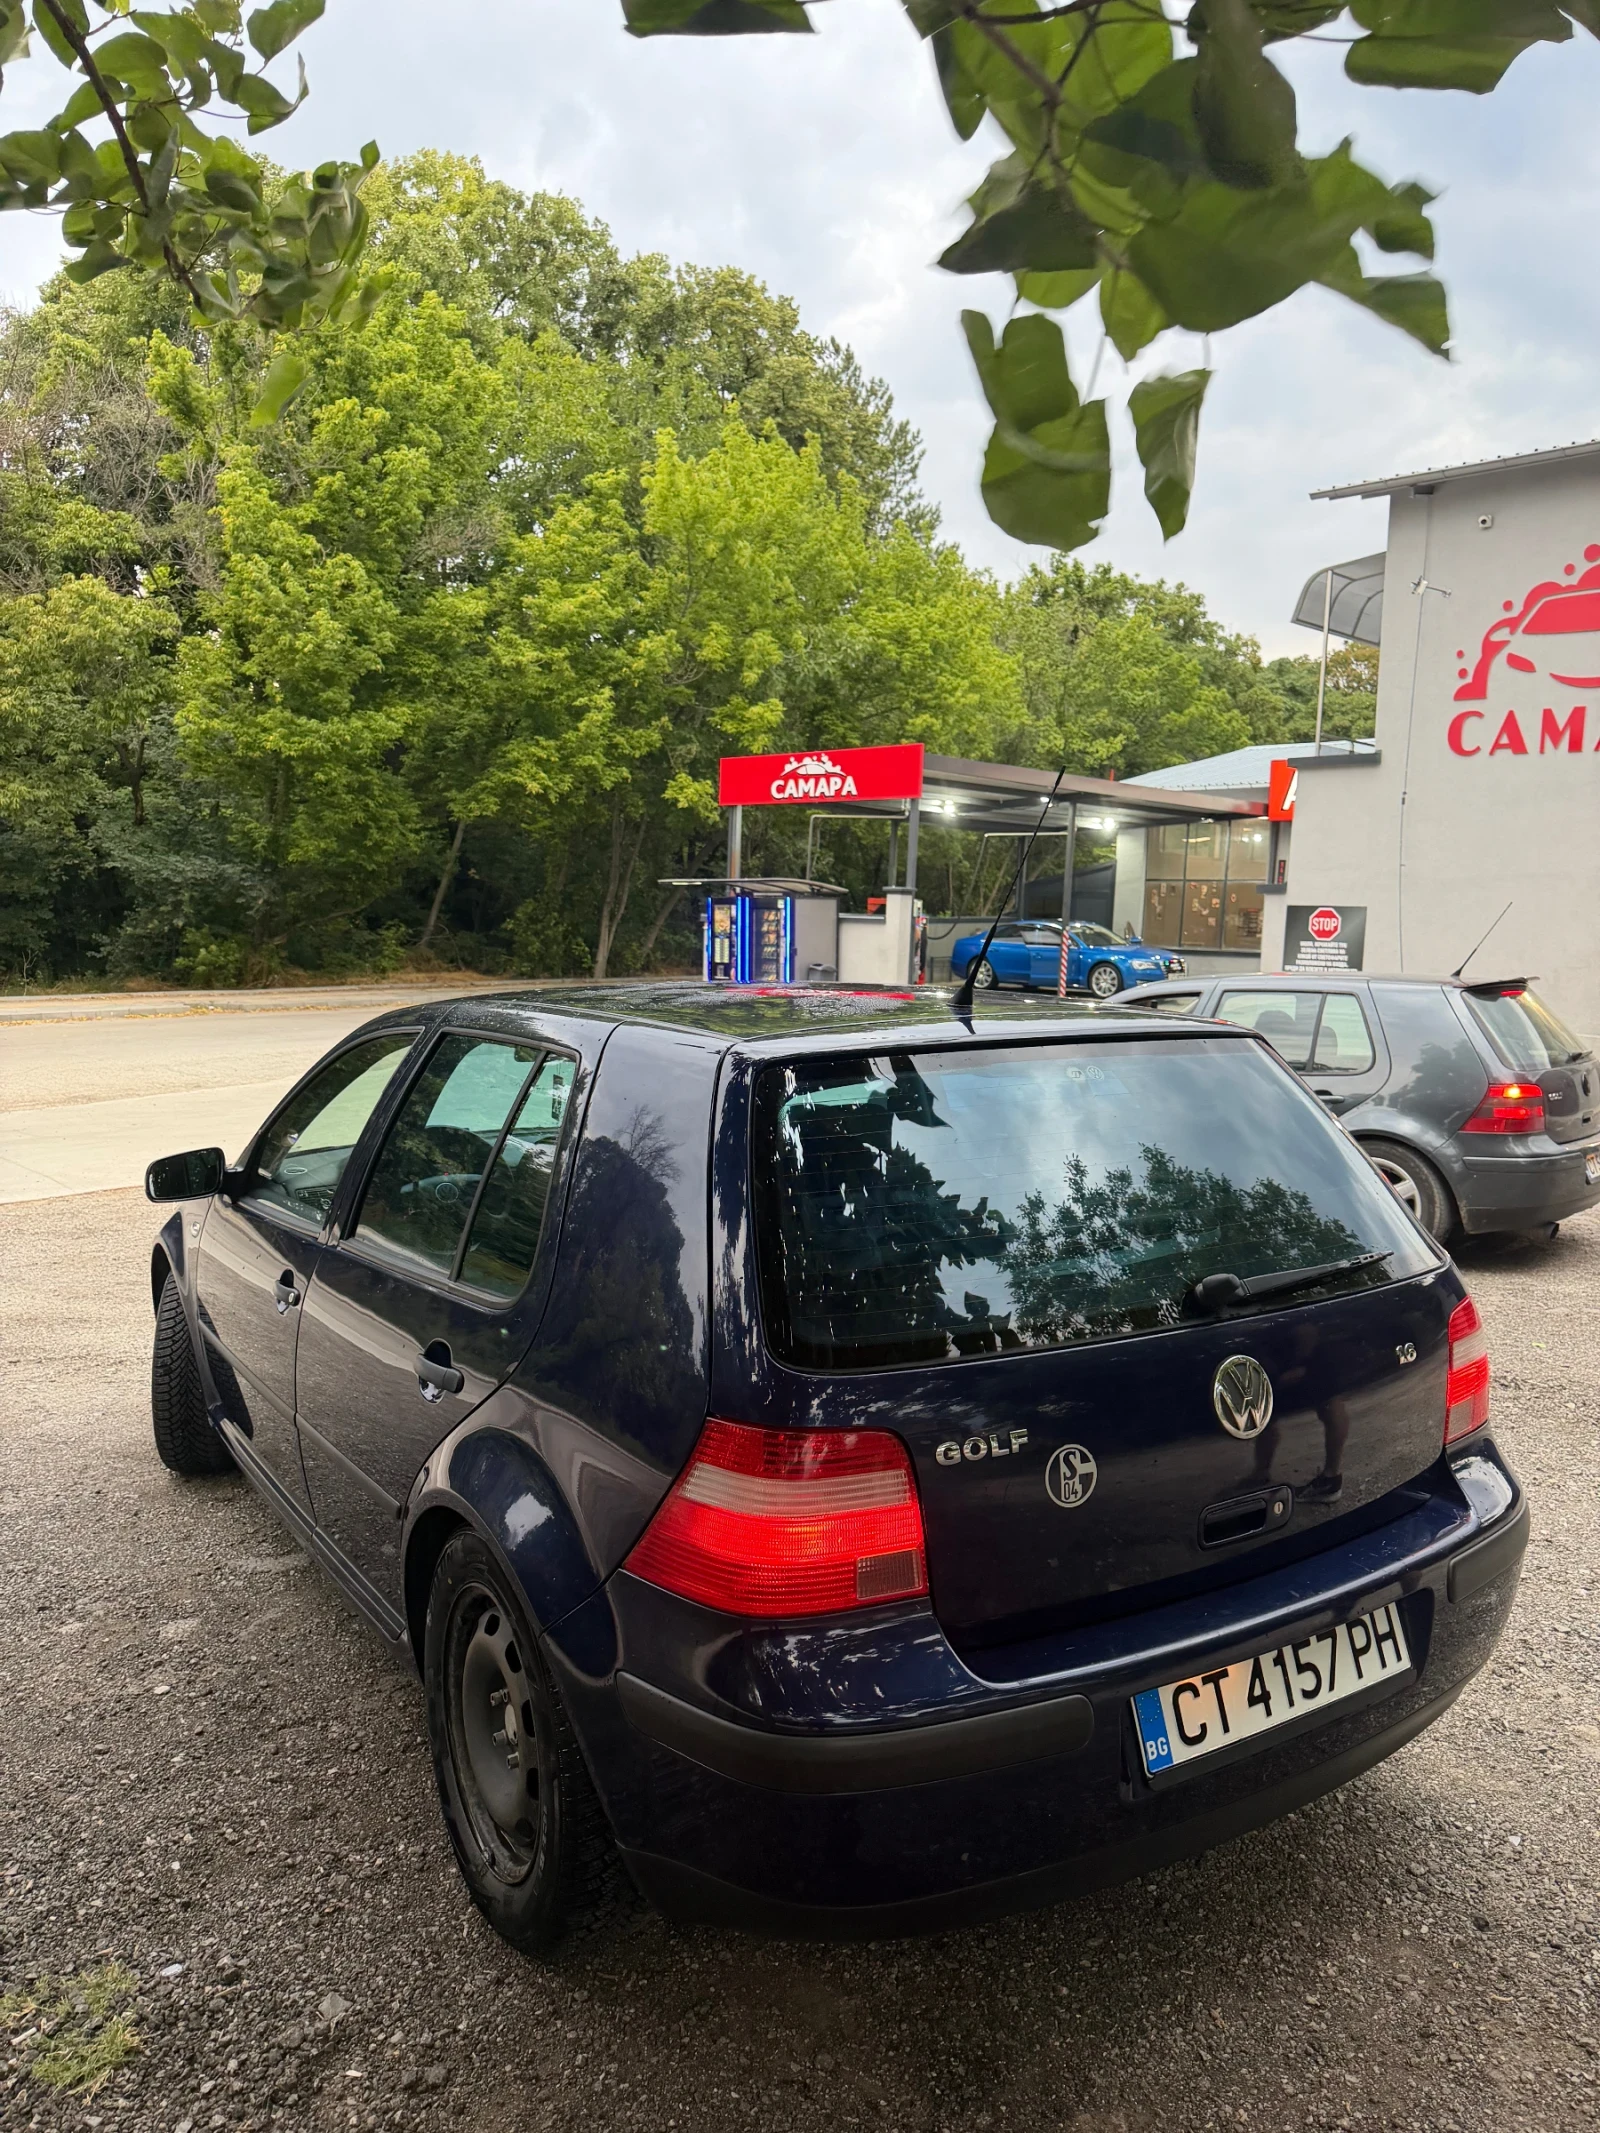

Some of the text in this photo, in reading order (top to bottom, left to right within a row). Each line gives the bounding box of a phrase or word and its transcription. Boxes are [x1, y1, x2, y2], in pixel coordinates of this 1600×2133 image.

[1447, 706, 1600, 757] САМ
[770, 775, 858, 800] САМАРА
[1311, 917, 1338, 932] STOP
[935, 1428, 1029, 1466] GOLF
[1171, 1605, 1403, 1747] CT 4157 PH
[1145, 1736, 1168, 1761] BG
